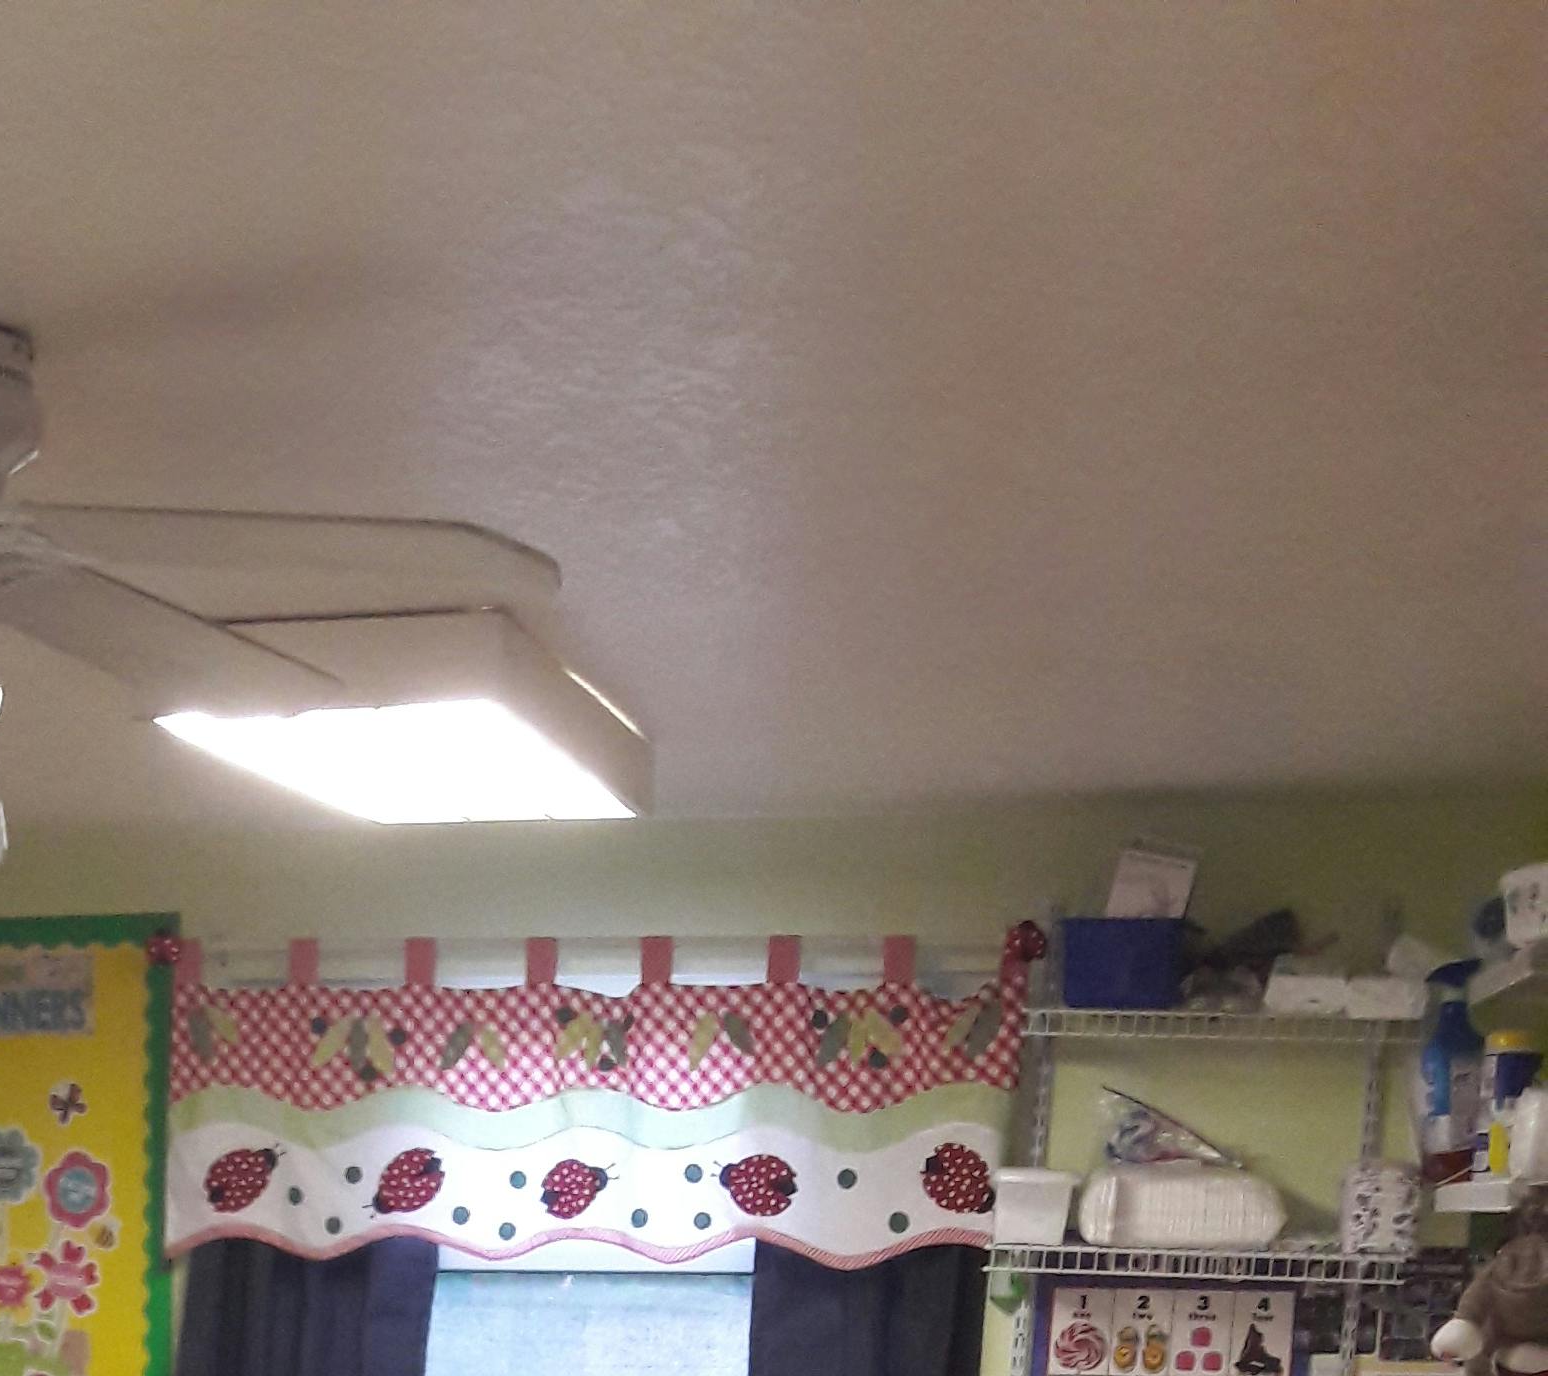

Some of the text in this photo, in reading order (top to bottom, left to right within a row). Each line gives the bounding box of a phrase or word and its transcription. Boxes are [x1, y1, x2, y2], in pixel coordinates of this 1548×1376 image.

[1080, 1295, 1270, 1311] 1 2 3 4
